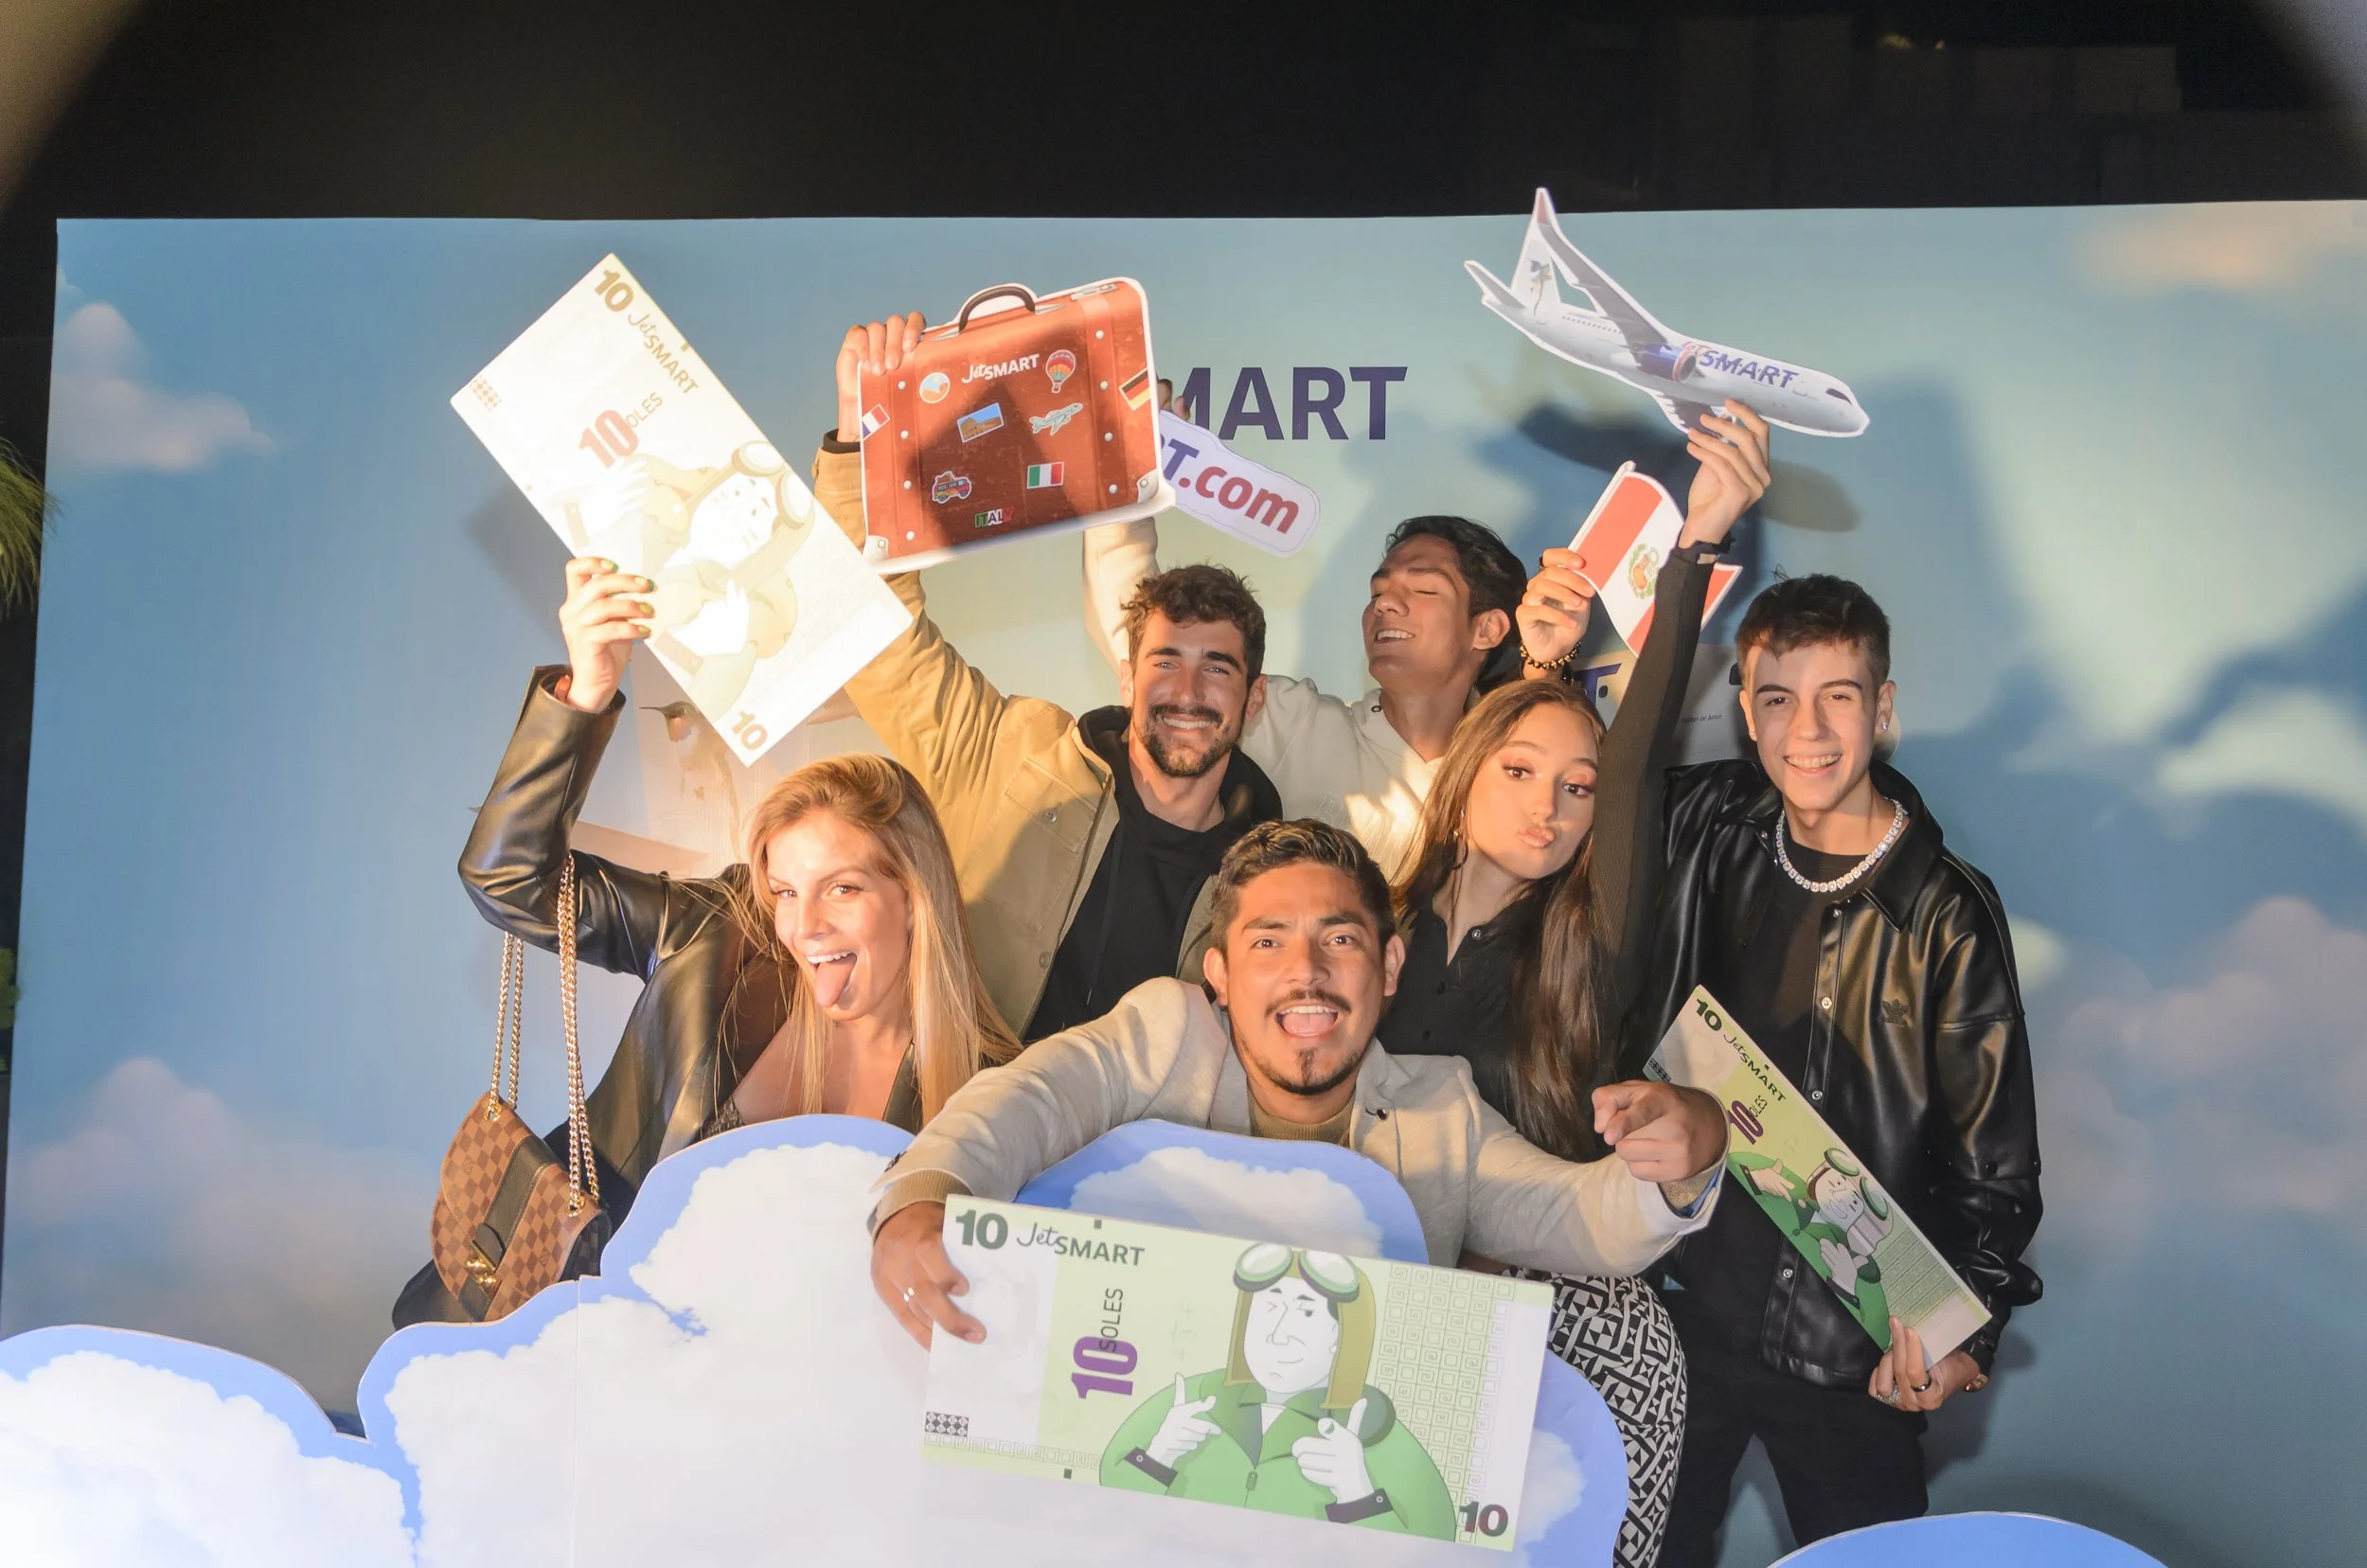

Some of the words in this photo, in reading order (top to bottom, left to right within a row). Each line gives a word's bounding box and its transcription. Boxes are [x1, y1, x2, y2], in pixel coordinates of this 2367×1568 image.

[595, 269, 633, 312] 10
[628, 313, 699, 394] JetSMART
[961, 353, 1040, 383] JetSMART
[578, 409, 639, 468] 10
[620, 391, 663, 432] OLES
[1160, 433, 1300, 535] T.com
[732, 711, 768, 750] 10
[1696, 998, 1722, 1031] 10
[1723, 1034, 1787, 1101] JetSMART
[1727, 1100, 1764, 1145] 10
[955, 1209, 1008, 1250] 10
[1017, 1221, 1146, 1266] JetSMART
[1098, 1288, 1124, 1352] SOLES
[1071, 1336, 1138, 1399] 10
[1459, 1501, 1509, 1537] 10
